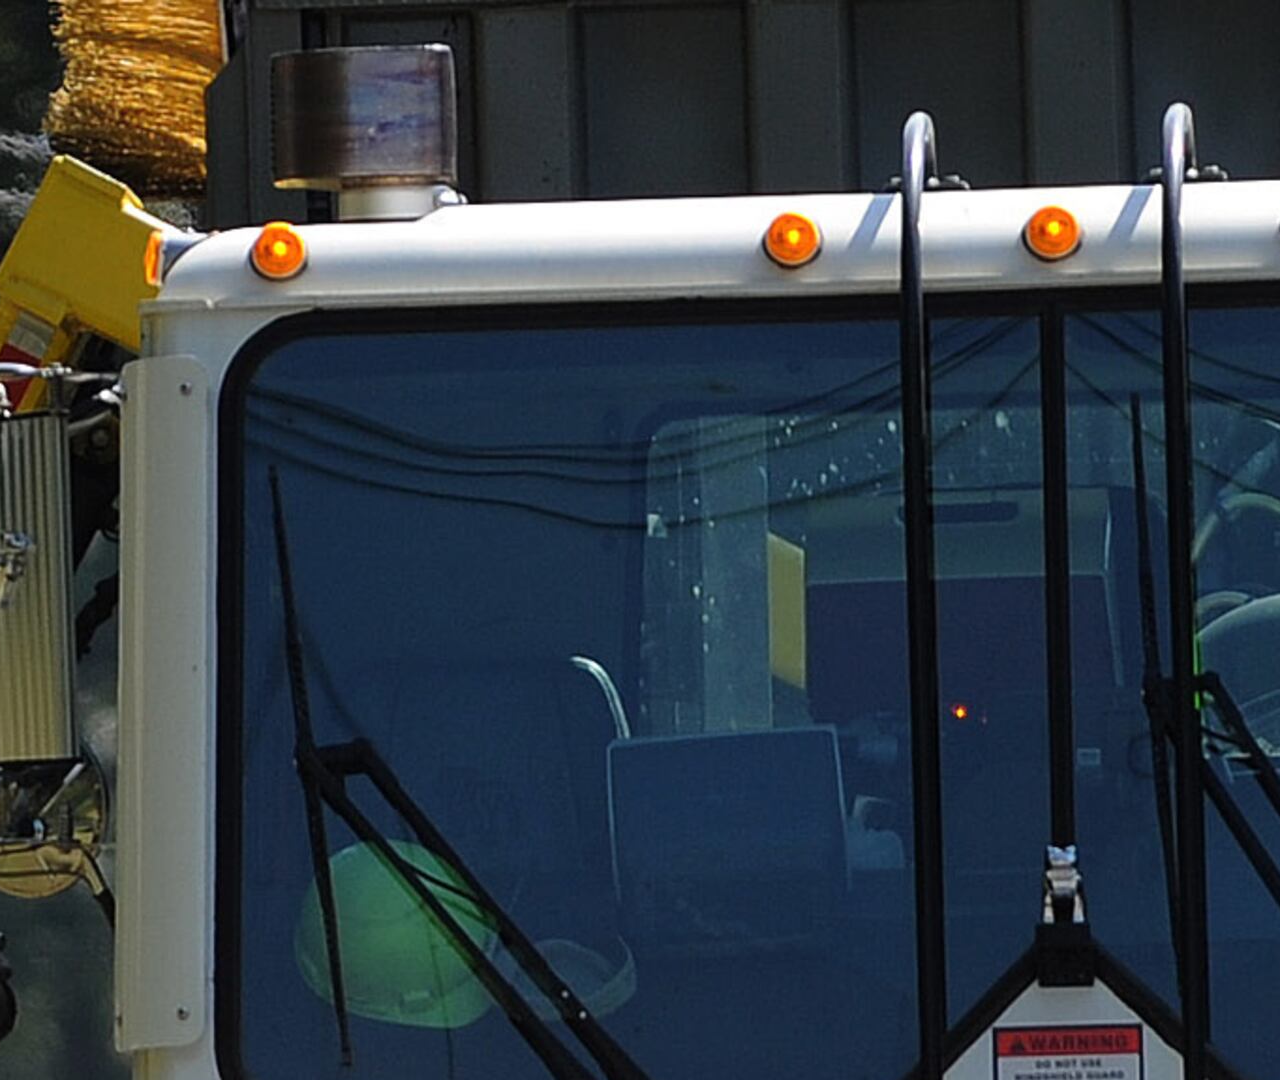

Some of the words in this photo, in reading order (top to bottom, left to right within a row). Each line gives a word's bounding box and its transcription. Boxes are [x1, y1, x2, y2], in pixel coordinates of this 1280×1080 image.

[1029, 1034, 1128, 1050] WARNING
[1035, 1060, 1051, 1069] DO
[1055, 1059, 1077, 1068] NOT
[1081, 1058, 1102, 1067] USE
